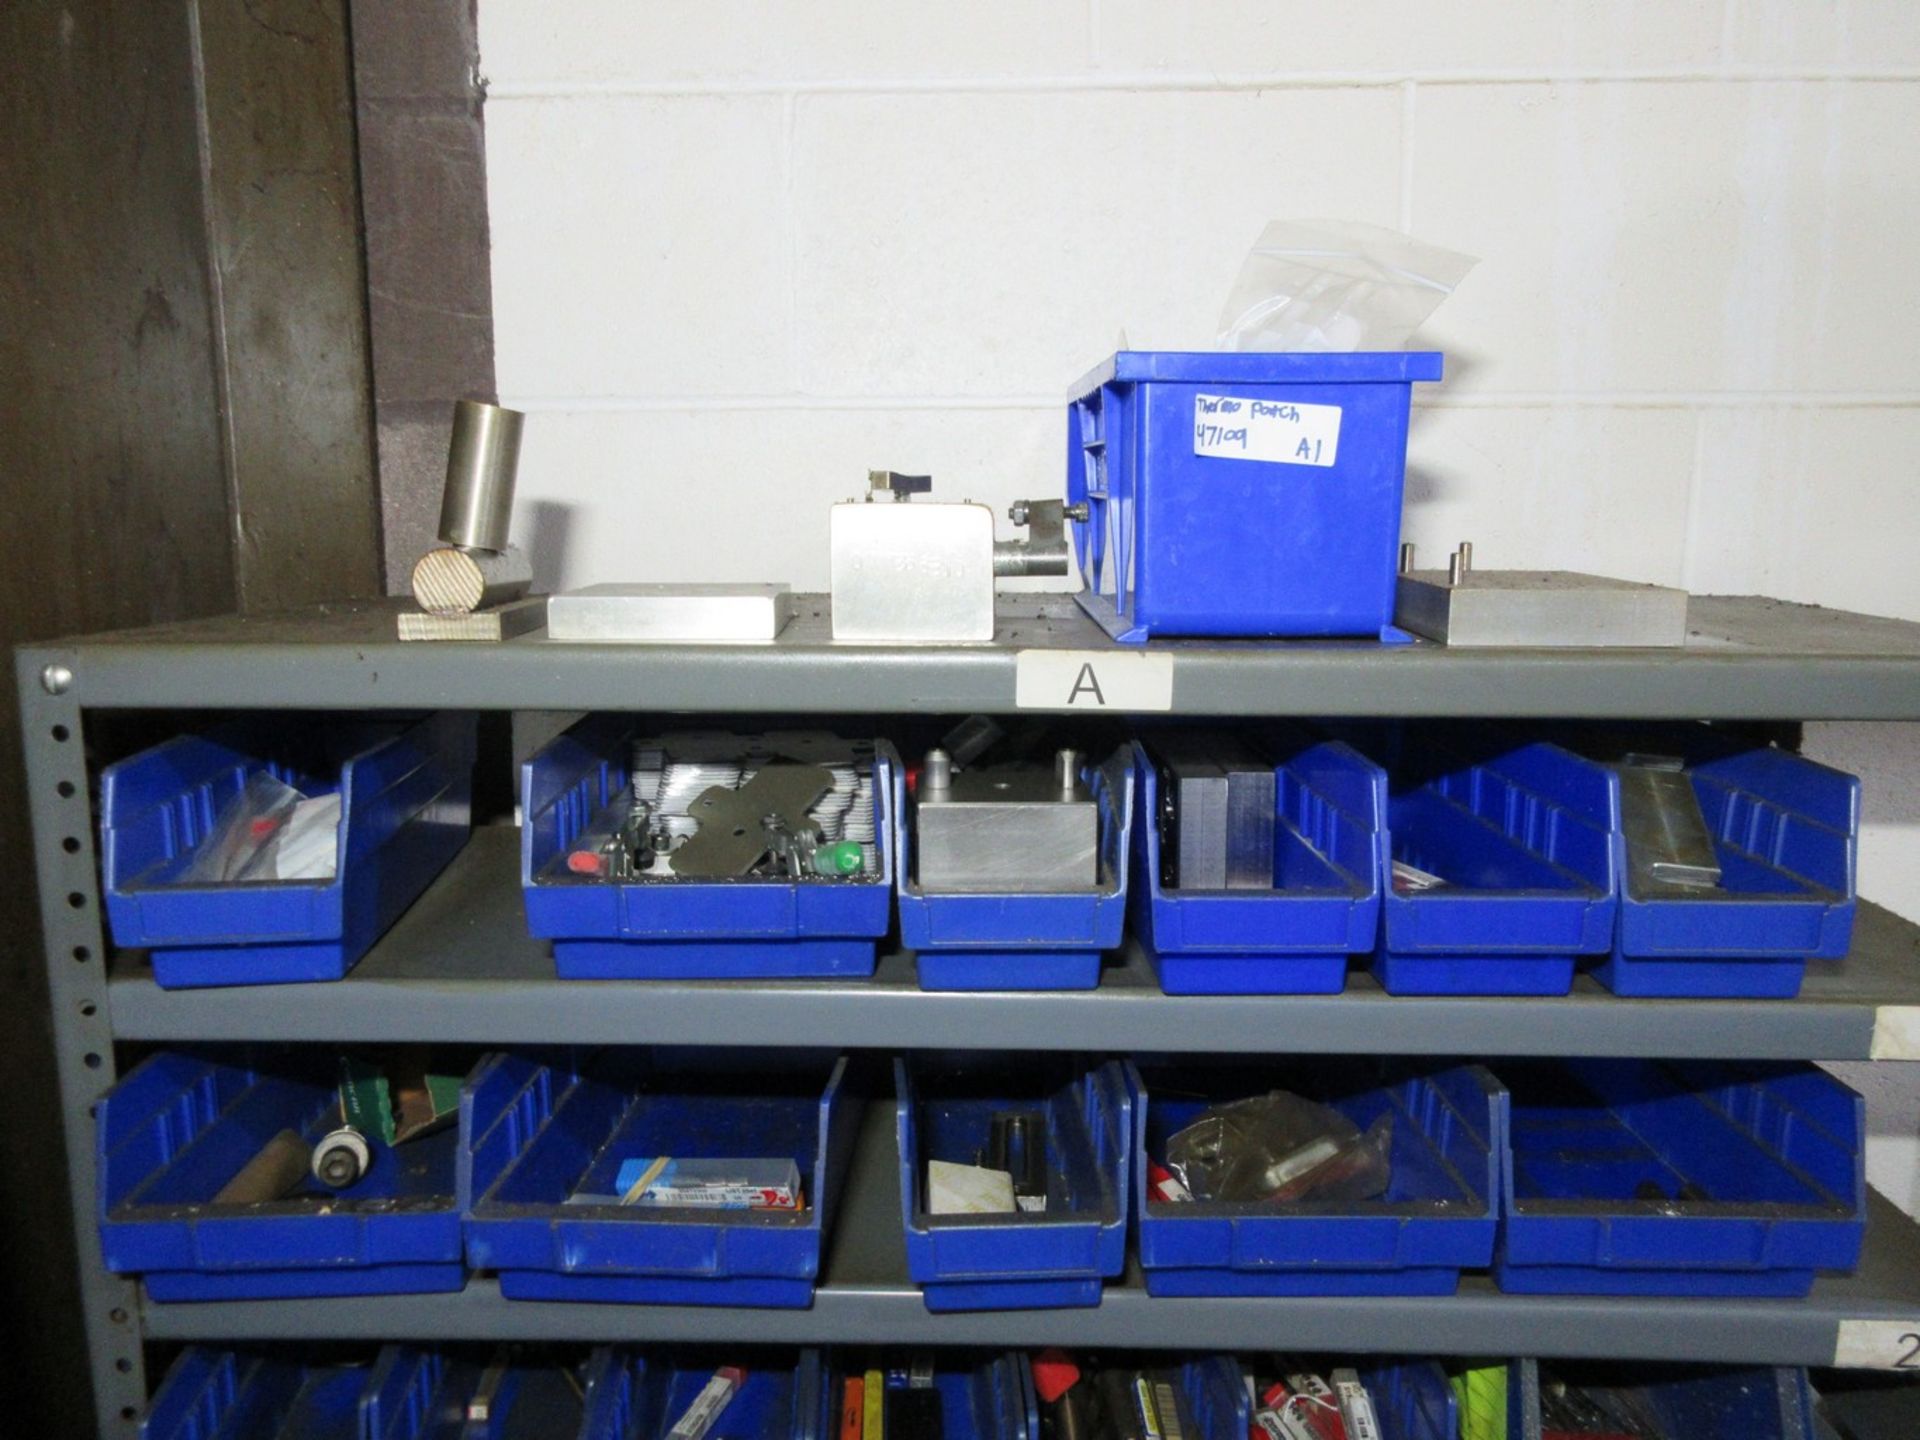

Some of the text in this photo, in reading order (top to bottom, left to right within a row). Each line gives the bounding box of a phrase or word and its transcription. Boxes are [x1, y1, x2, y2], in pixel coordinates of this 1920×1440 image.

[1196, 423, 1247, 449] 47109
[1067, 662, 1105, 705] A
[1893, 1333, 1920, 1368] 2
